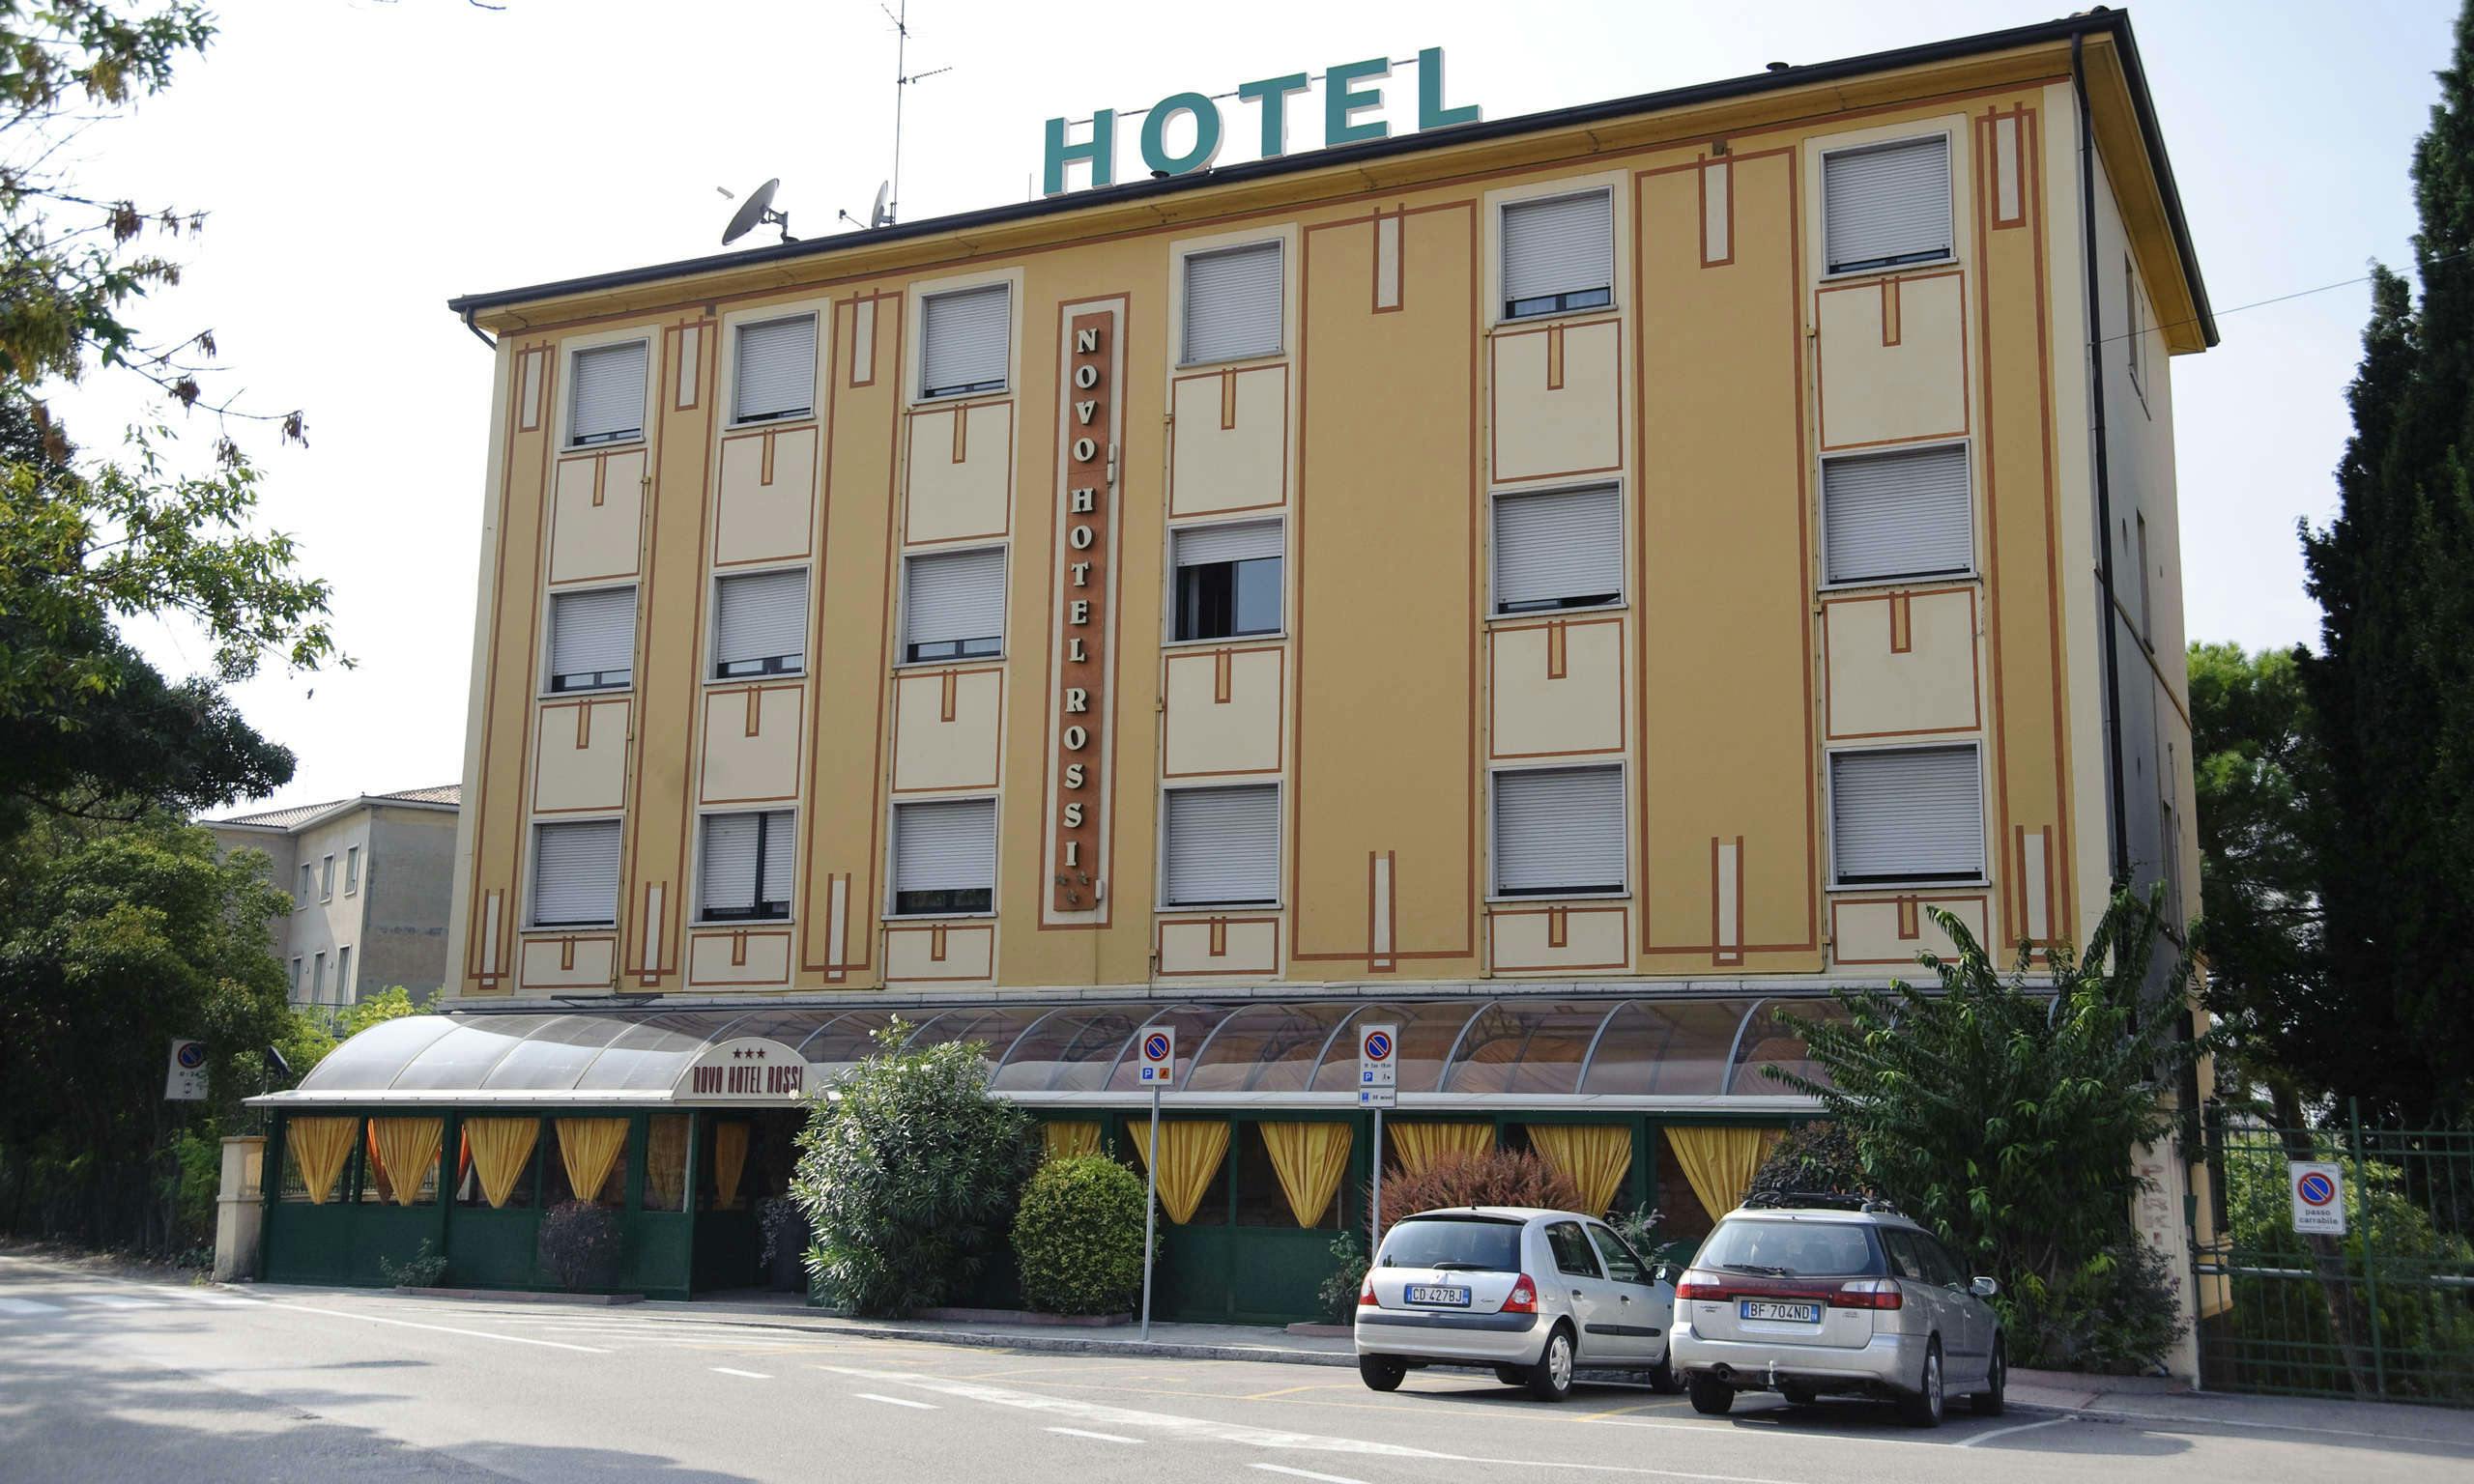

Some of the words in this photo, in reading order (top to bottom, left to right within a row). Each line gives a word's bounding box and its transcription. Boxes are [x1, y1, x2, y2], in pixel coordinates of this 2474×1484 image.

[1043, 45, 1483, 198] HOTEL
[1073, 328, 1099, 462] NOVO
[1068, 487, 1094, 663] HOTEL
[1063, 687, 1087, 867] ROSSI
[693, 1066, 724, 1094] NOVO
[728, 1066, 762, 1094] HOTEL
[766, 1066, 803, 1094] ROSSI
[2299, 1216, 2339, 1225] carrabile
[1413, 1288, 1426, 1300] CD
[1429, 1289, 1462, 1302] 427BJ
[1750, 1303, 1767, 1317] BF
[1770, 1304, 1810, 1320] 704ND
